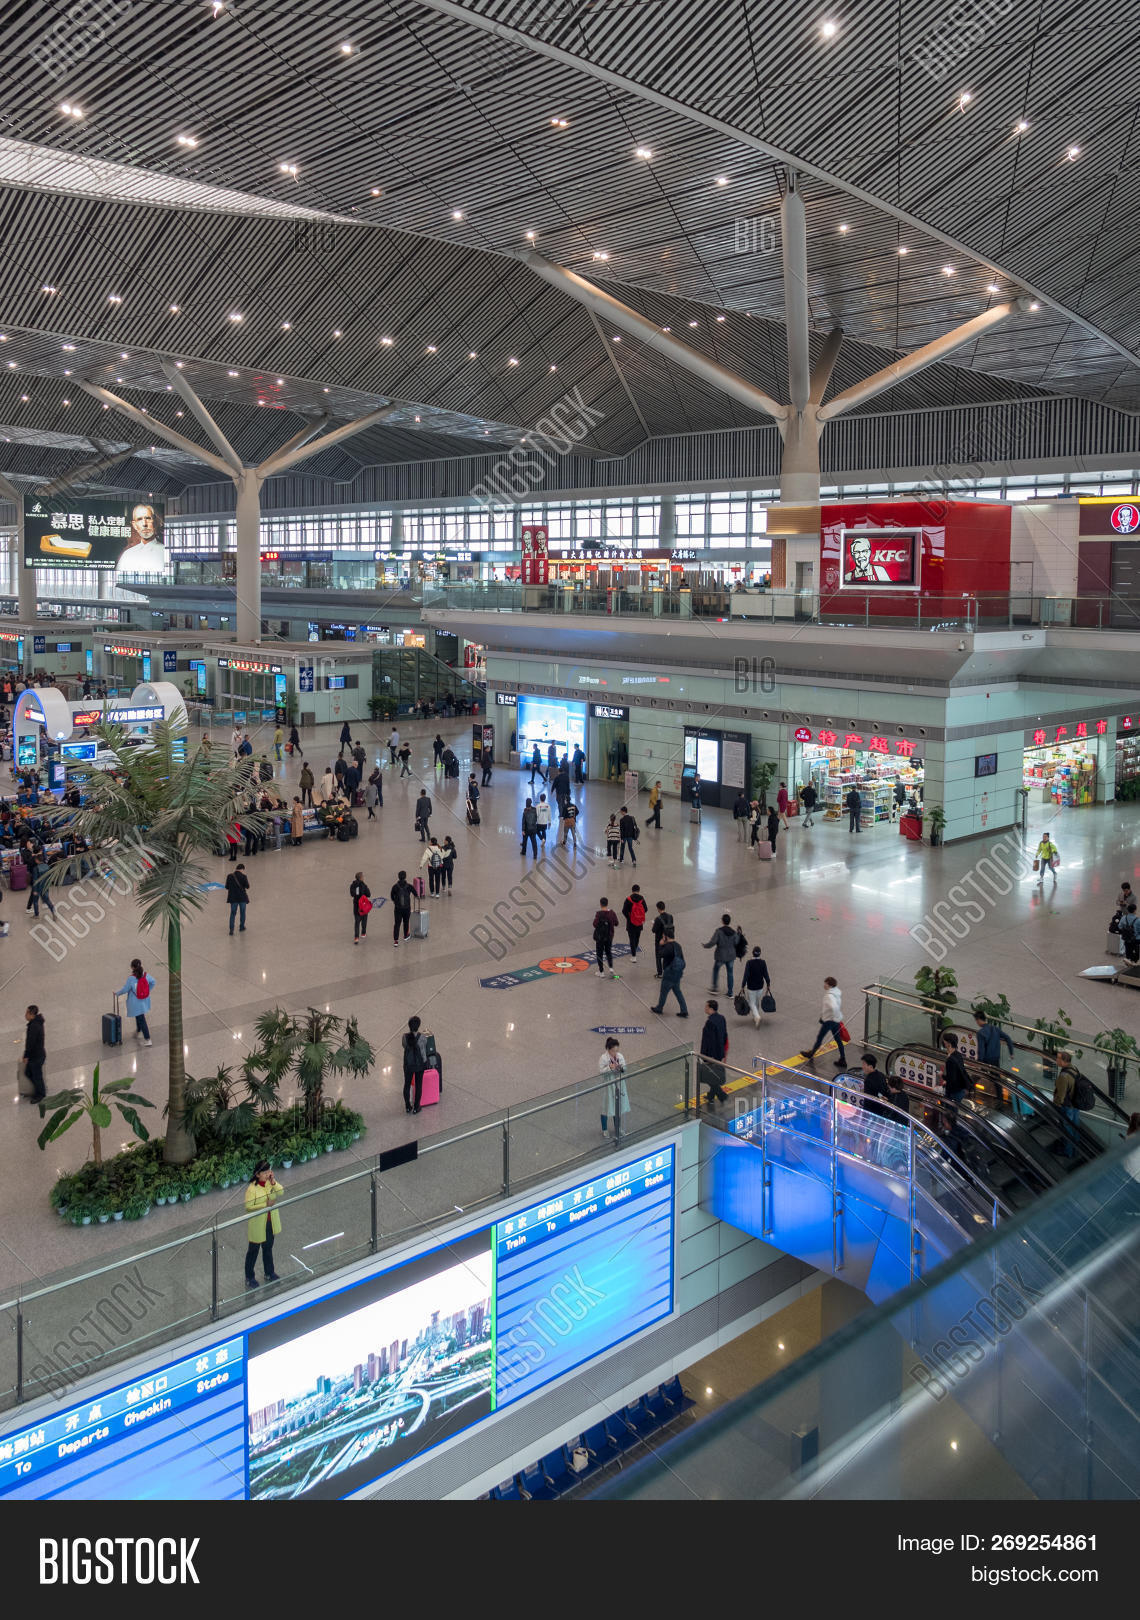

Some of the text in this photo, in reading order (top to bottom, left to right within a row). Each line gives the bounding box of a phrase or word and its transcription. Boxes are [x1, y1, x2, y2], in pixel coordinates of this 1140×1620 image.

[51, 512, 85, 530] 慕思
[88, 515, 126, 526] 私人定制
[873, 549, 907, 562] KFC
[165, 653, 176, 661] A4
[301, 670, 313, 678] A2
[817, 729, 918, 757] 特产超市
[1033, 719, 1108, 745] 特产超市
[505, 1173, 664, 1250] Train To Departs Checkin State
[65, 1404, 103, 1432] 开点
[195, 1349, 229, 1373] 状态
[15, 1372, 229, 1476] To Departs Checkin State
